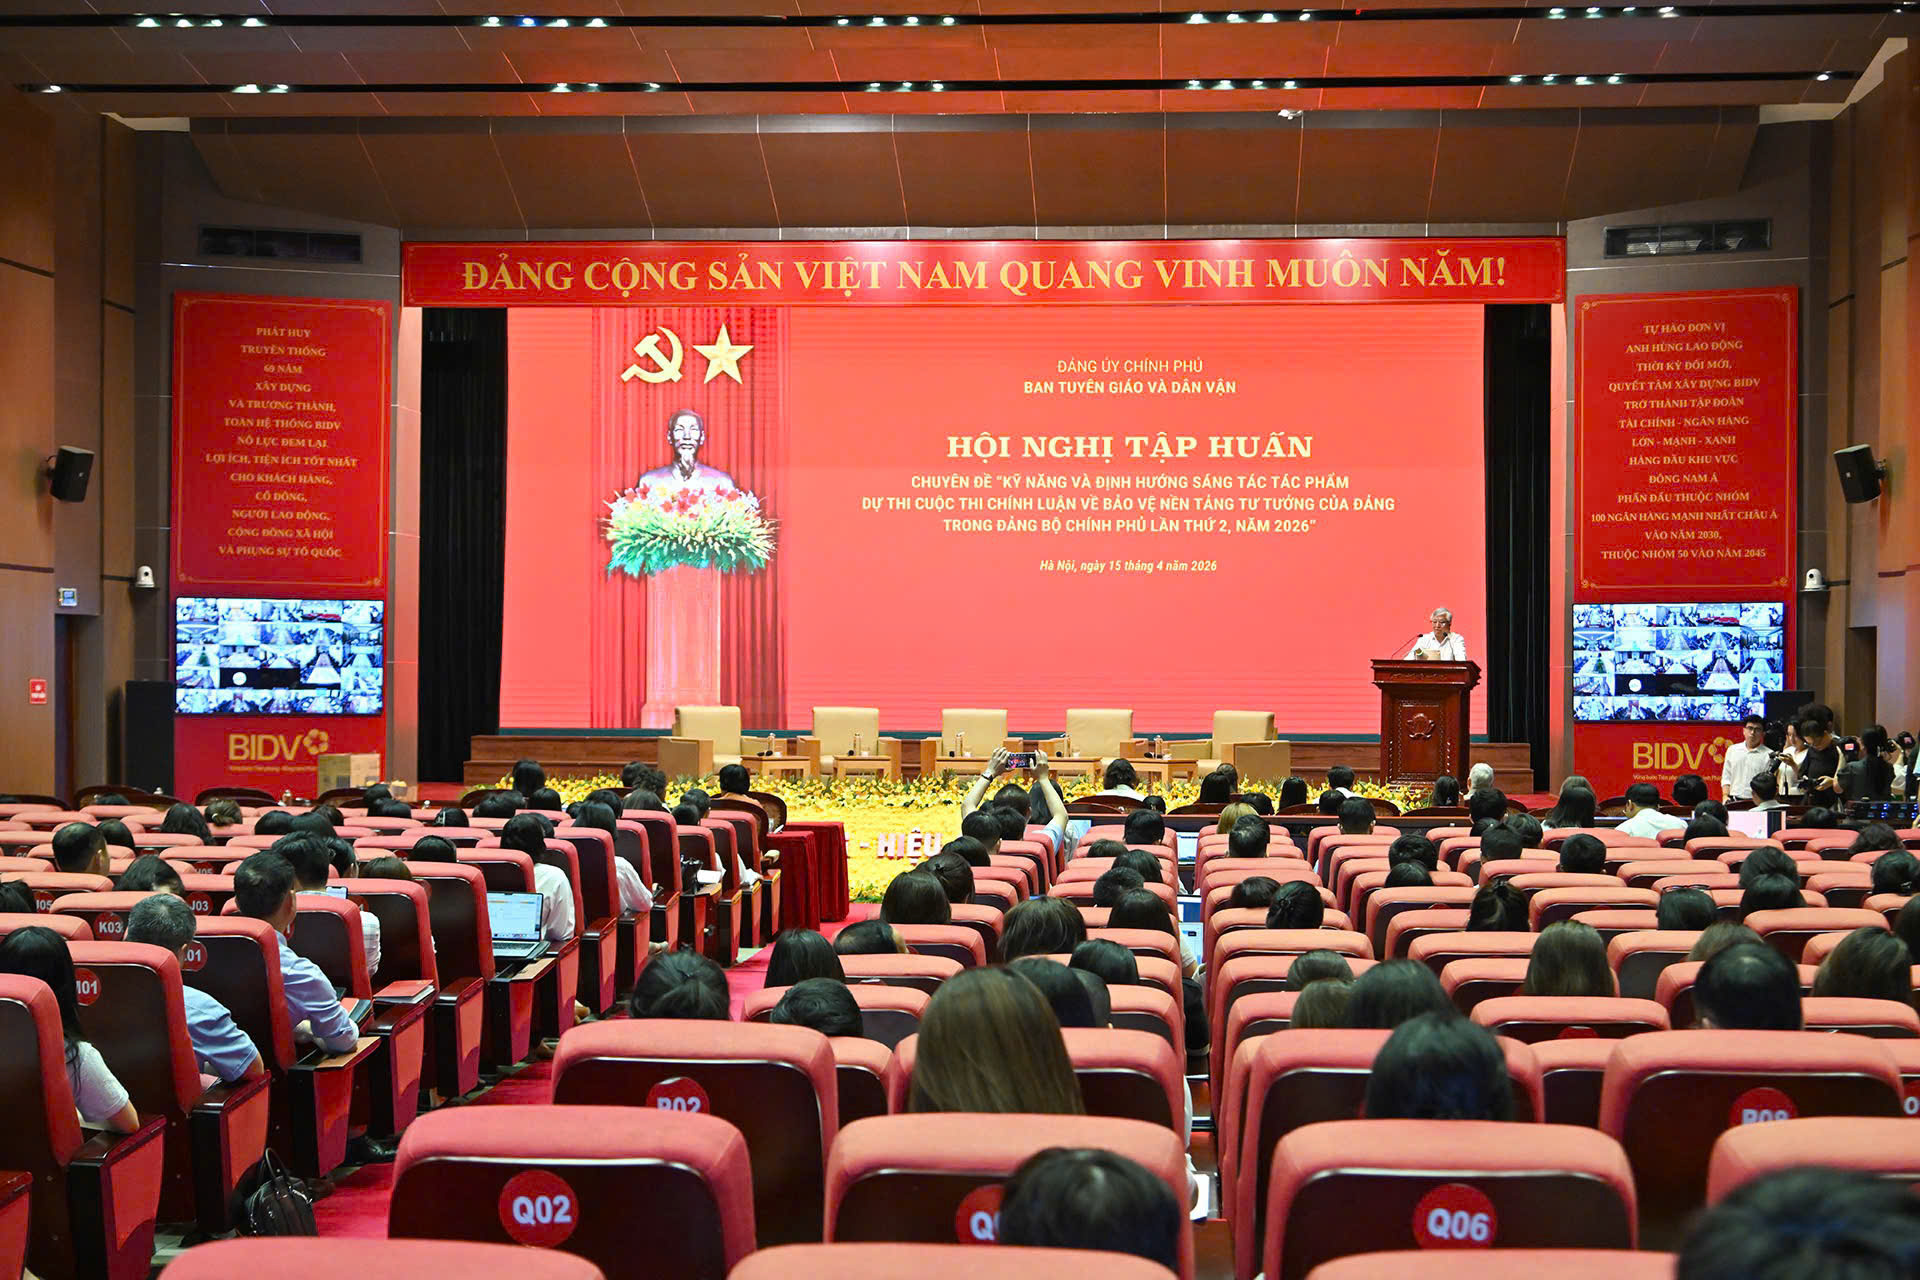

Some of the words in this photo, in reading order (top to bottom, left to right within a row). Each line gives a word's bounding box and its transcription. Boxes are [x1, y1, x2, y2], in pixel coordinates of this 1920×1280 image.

[462, 255, 573, 290] ĐẢNG
[584, 257, 697, 297] CỘNG
[708, 254, 783, 290] SẢN
[793, 256, 887, 296] VIỆT
[897, 261, 989, 289] NAM
[999, 260, 1143, 295] QUANG
[1152, 260, 1255, 288] VINH
[1266, 250, 1388, 286] MUÔN
[1400, 250, 1504, 286] NĂM!
[1057, 356, 1097, 372] ĐẢNG
[1101, 357, 1119, 372] ỦY
[1123, 358, 1168, 372] CHÍNH
[1173, 356, 1202, 372] PHỦ
[1023, 381, 1053, 393] BAN
[1057, 378, 1104, 394] TUYÊN
[1108, 378, 1143, 393] GIÁO
[1147, 378, 1167, 393] VÀ
[1171, 378, 1201, 393] DÂN
[1205, 378, 1236, 396] VẬN
[946, 431, 1010, 463] HỘI
[1021, 436, 1113, 463] NGHỊ
[1124, 431, 1197, 463] TẬP
[1207, 431, 1312, 458] HUẤN
[911, 473, 969, 488] CHUYÊN
[973, 472, 992, 488] ĐỀ
[1025, 473, 1067, 488] NĂNG
[1071, 472, 1091, 488] VÀ
[1095, 476, 1131, 490] ĐỊNH
[1135, 472, 1188, 488] HƯỚNG
[1192, 473, 1232, 488] SÁNG
[1236, 473, 1266, 488] TÁC
[1270, 473, 1300, 488] TÁC
[1304, 472, 1348, 488] PHẨM
[862, 496, 884, 512] DỰ
[886, 497, 910, 509] THI
[914, 494, 954, 512] CUỘC
[958, 497, 982, 510] THI
[987, 494, 1032, 510] CHÍNH
[1037, 494, 1076, 512] LUẬN
[1080, 494, 1098, 510] VỀ
[1103, 494, 1133, 510] BẢO
[1137, 495, 1156, 512] VỆ
[1159, 494, 1189, 510] NỀN
[1193, 493, 1234, 510] TẢNG
[1238, 497, 1260, 510] TƯ
[1262, 494, 1314, 510] TƯỞNG
[1319, 494, 1349, 510] CỦA
[1352, 494, 1394, 510] ĐẢNG
[943, 519, 992, 531] TRONG
[996, 515, 1037, 532] ĐẢNG
[1041, 516, 1061, 534] BỘ
[1065, 516, 1111, 532] CHÍNH
[1116, 515, 1146, 532] PHỦ
[1150, 516, 1179, 532] LẦN
[1183, 516, 1216, 532] THỨ
[1218, 519, 1231, 534] 2,
[1236, 517, 1270, 532] NĂM
[1039, 559, 1054, 570] Hà
[1056, 559, 1077, 572] Nội,
[1080, 559, 1106, 573] ngày
[1109, 559, 1121, 571] 15
[1124, 559, 1154, 574] tháng
[1156, 560, 1163, 570] 4
[1165, 559, 1188, 571] năm
[1190, 559, 1216, 571] 2026
[229, 734, 303, 760] BIDV
[1633, 743, 1708, 769] BIDV
[191, 900, 209, 911] J03
[99, 921, 121, 933] K03
[184, 949, 201, 961] 01
[513, 1195, 572, 1226] Q02
[1428, 1208, 1489, 1241] Q06
